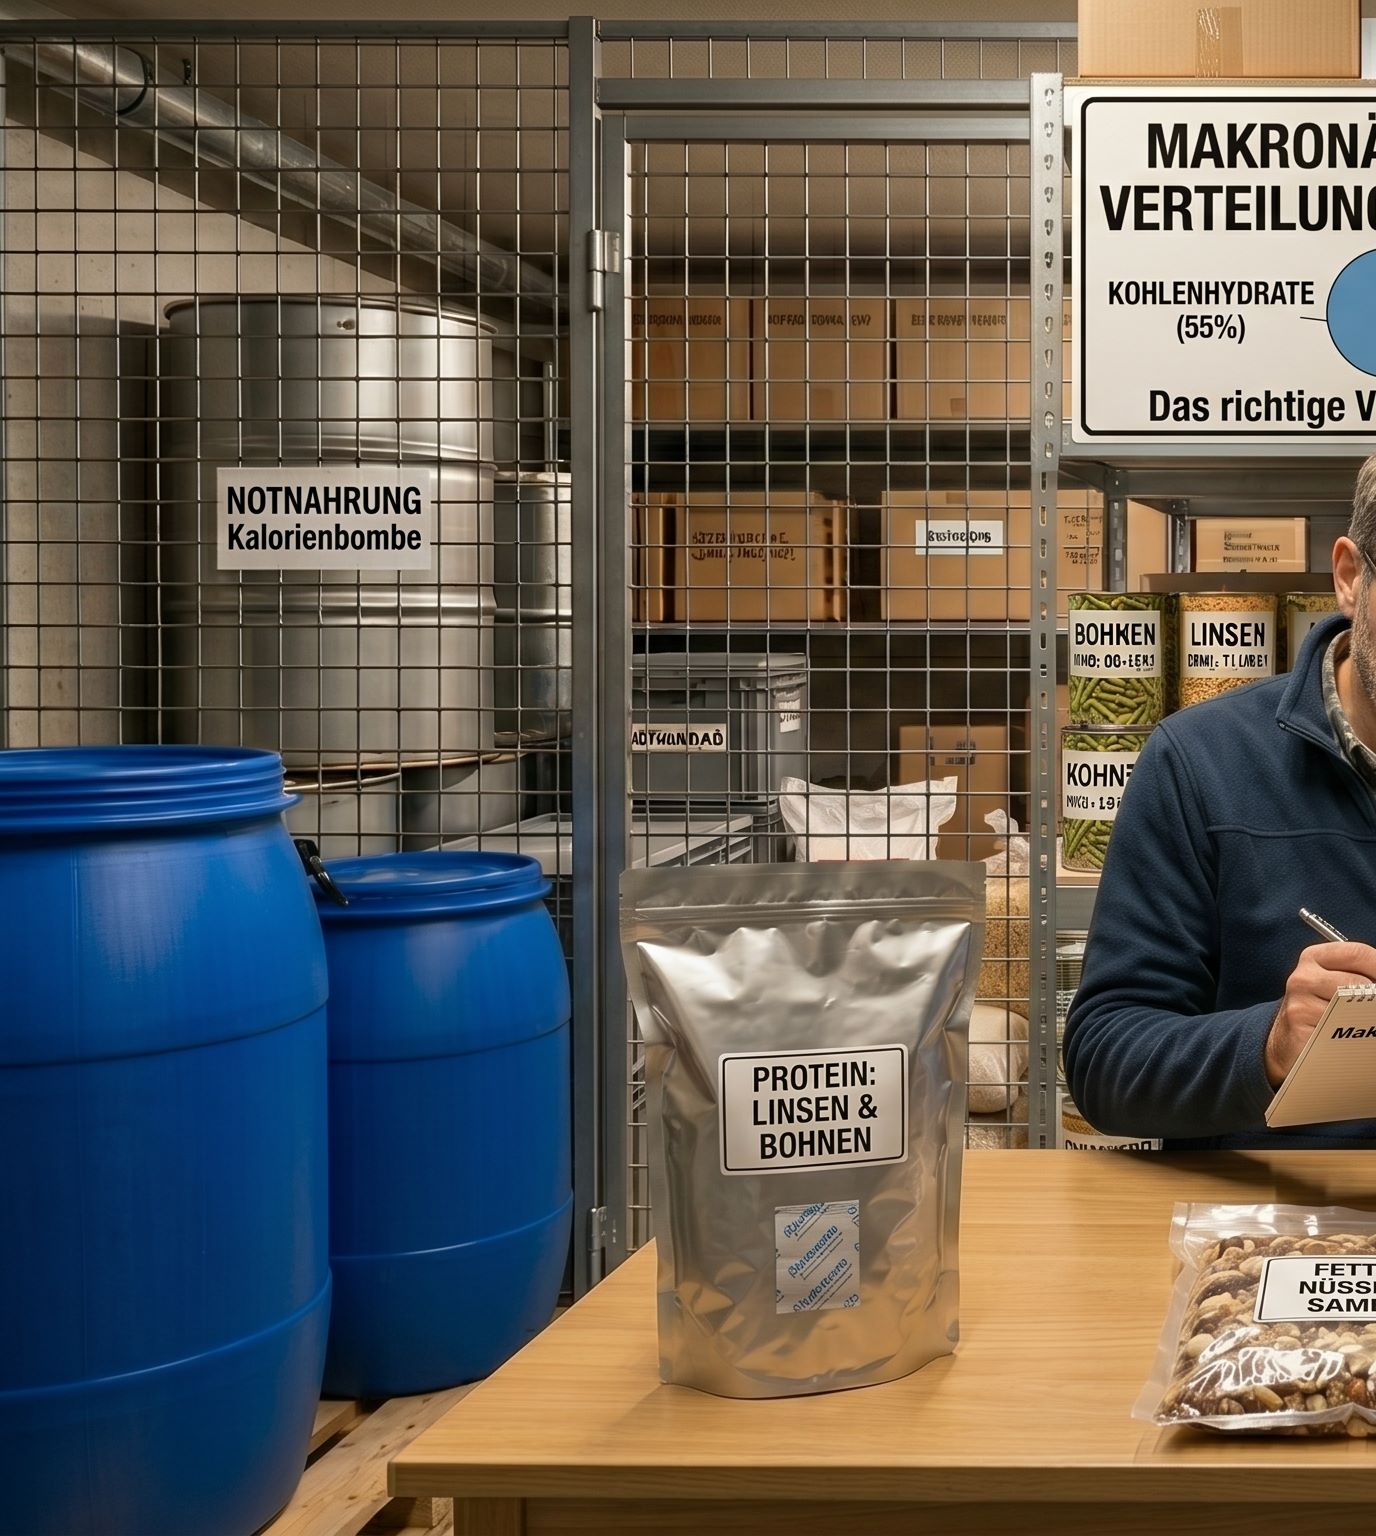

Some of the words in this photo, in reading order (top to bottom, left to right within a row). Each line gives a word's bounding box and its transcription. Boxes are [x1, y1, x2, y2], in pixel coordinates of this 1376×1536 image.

[1108, 281, 1315, 306] KOHLENHYDRATE
[1175, 314, 1246, 344] (55%)
[1149, 390, 1210, 422] Das
[1221, 389, 1347, 429] richtige
[227, 486, 422, 515] NOTNAHRUNG
[227, 523, 422, 552] Kalorienbombe
[1191, 622, 1265, 647] LINSEN
[753, 1062, 877, 1093] PROTEIN:
[752, 1094, 850, 1127] LINSEN
[856, 1094, 879, 1120] &
[759, 1126, 873, 1161] BOHNEN
